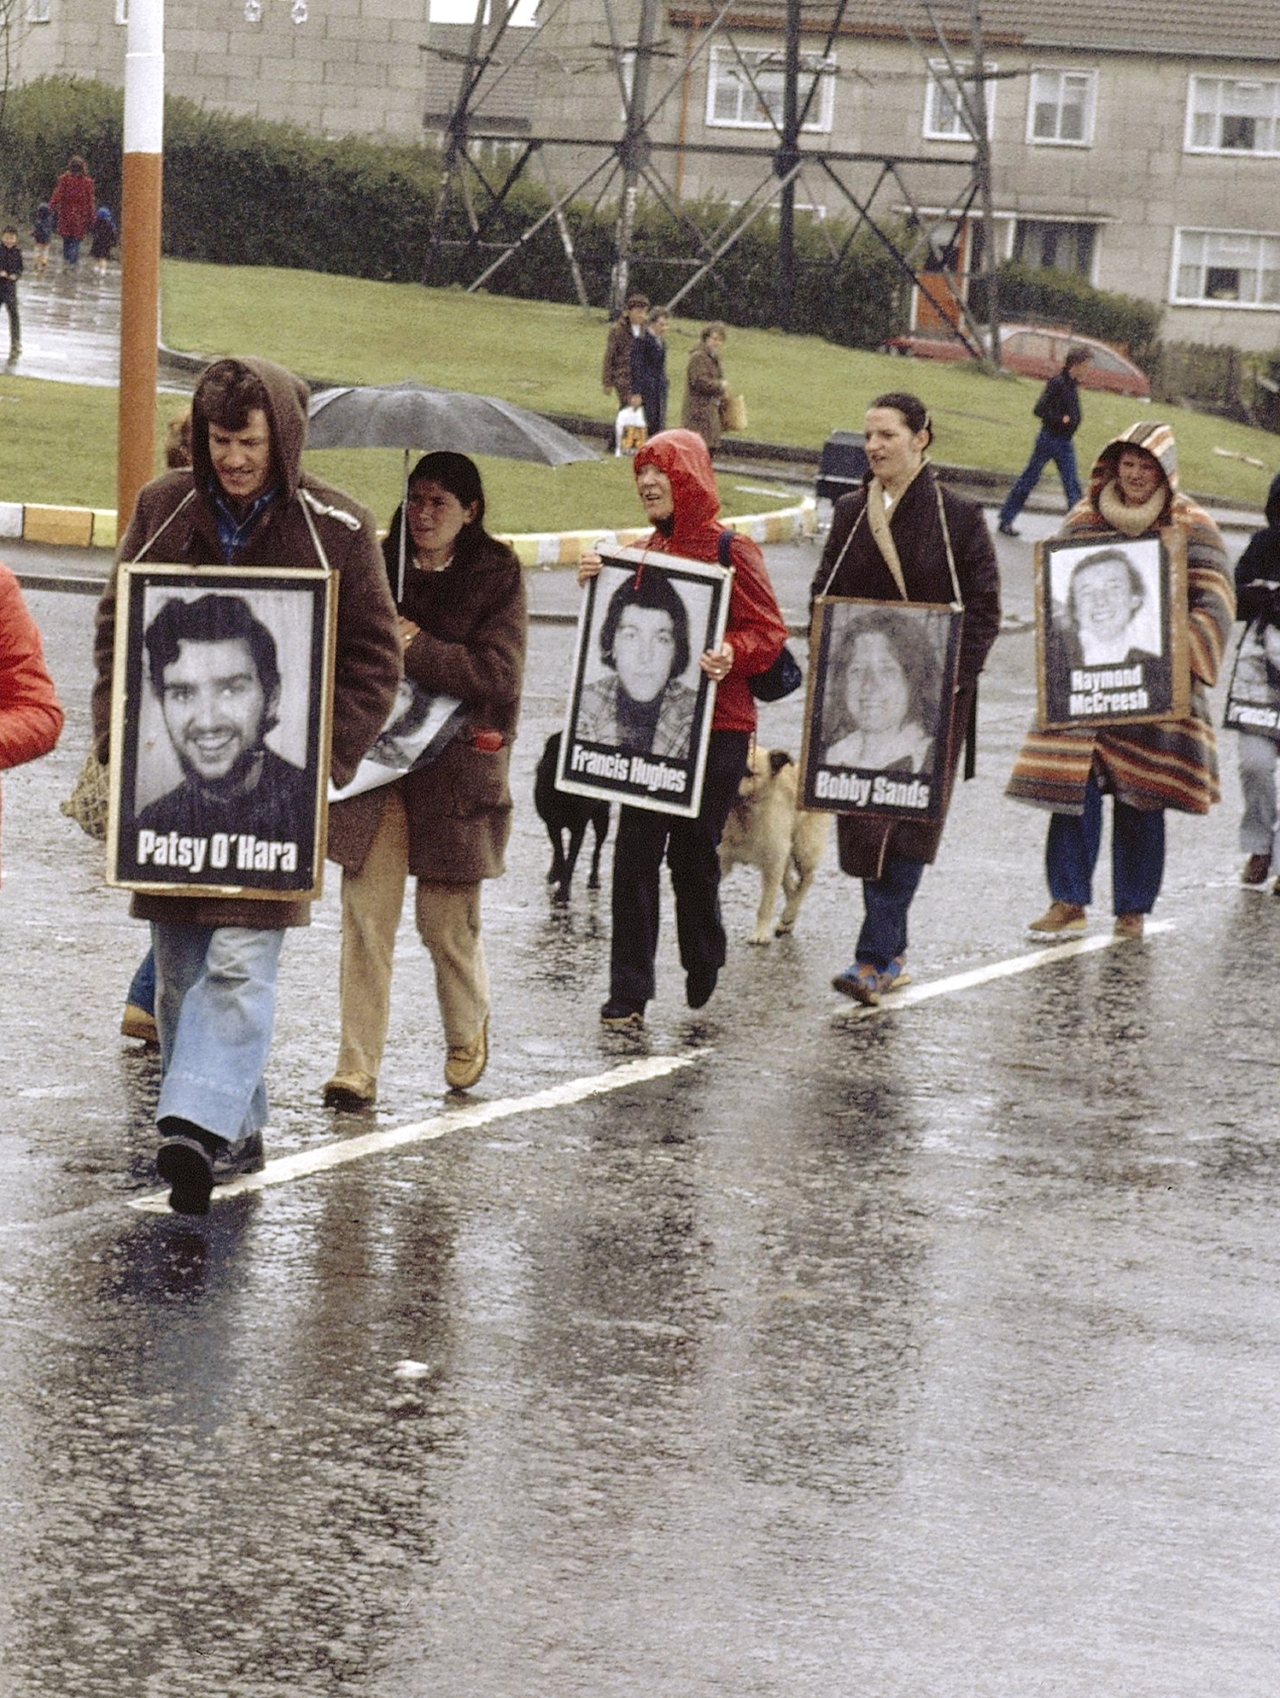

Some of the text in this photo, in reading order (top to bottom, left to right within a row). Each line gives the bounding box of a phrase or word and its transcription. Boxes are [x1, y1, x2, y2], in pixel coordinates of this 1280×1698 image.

[1071, 664, 1142, 692] Raymond
[1070, 688, 1148, 716] McCreesh
[571, 744, 687, 793] Francis Hughes
[815, 770, 931, 809] Bobby Sands
[137, 829, 298, 873] Patsy O'Hara
